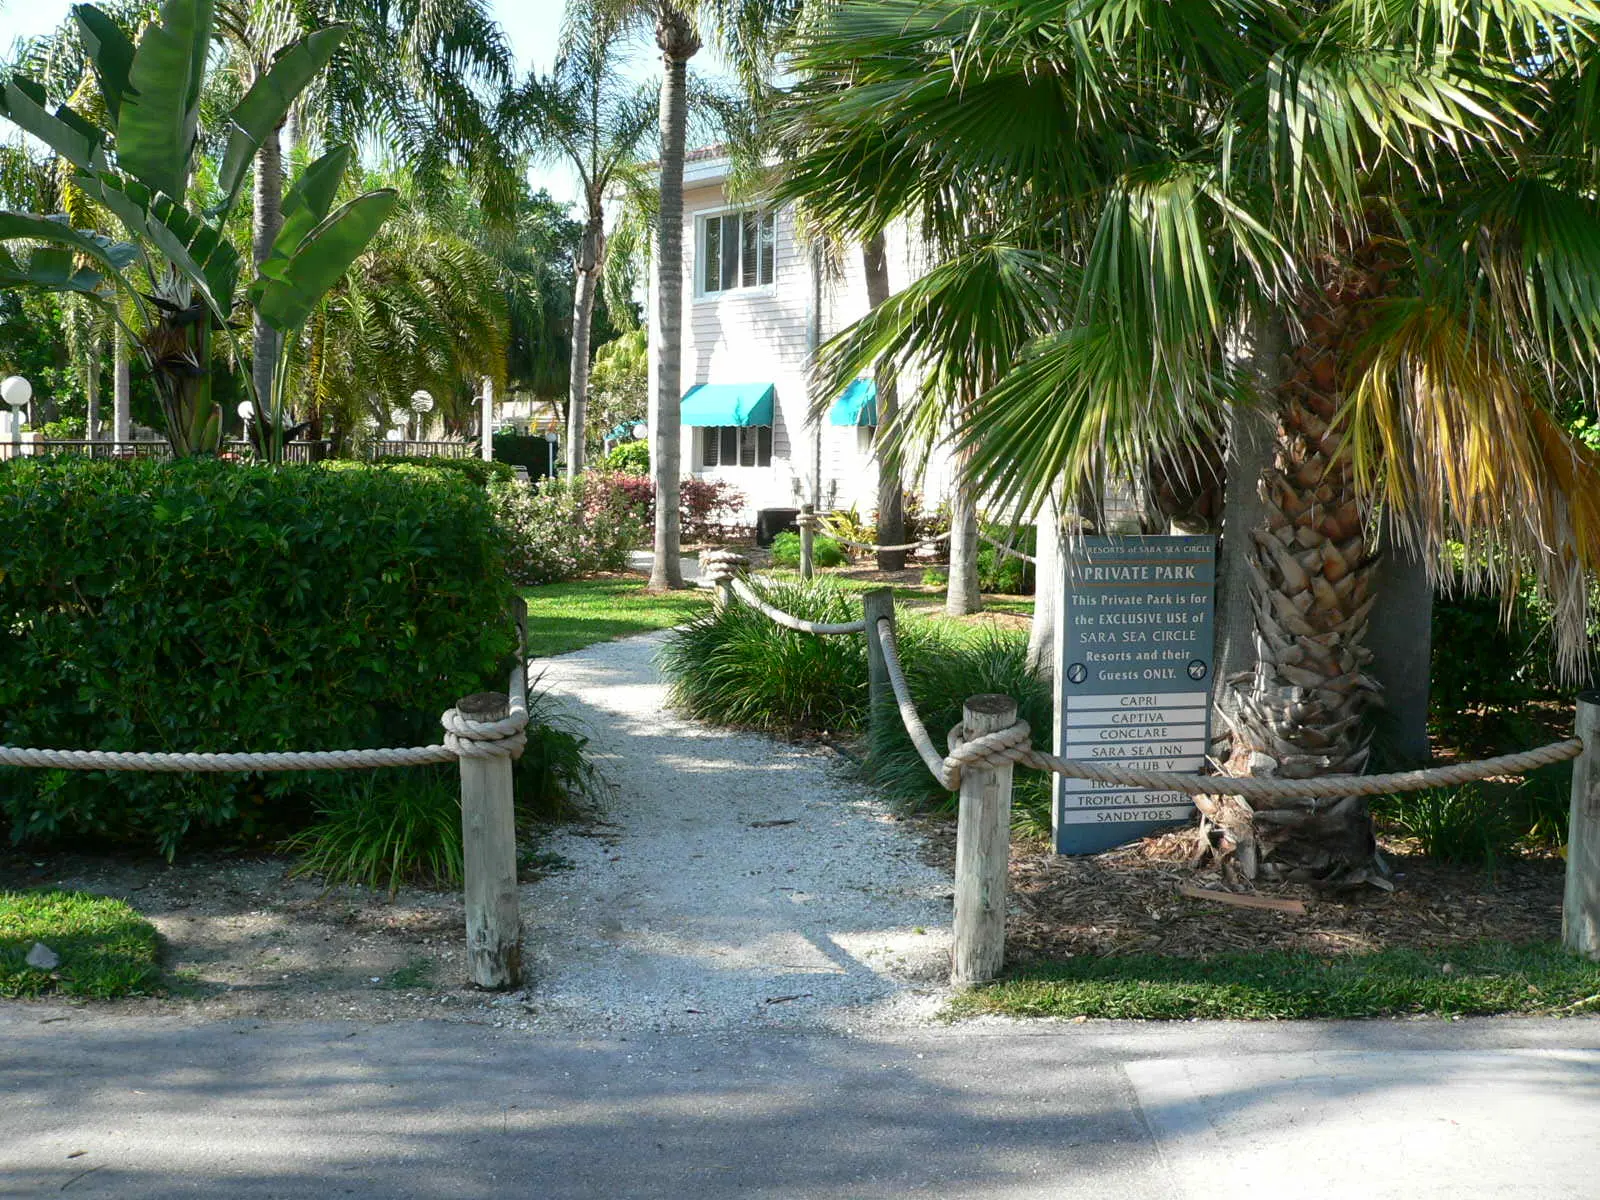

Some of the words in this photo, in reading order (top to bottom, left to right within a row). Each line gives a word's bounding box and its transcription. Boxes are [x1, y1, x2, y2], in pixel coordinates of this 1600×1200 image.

[1183, 545, 1211, 553] CIRCLE
[1084, 566, 1149, 580] PRIVATE
[1155, 565, 1195, 580] PARK
[1072, 595, 1097, 606] This
[1101, 594, 1142, 605] Private
[1147, 594, 1172, 605] Park
[1176, 594, 1185, 604] is
[1190, 593, 1207, 604] for
[1075, 614, 1094, 625] the
[1099, 613, 1161, 624] EXCLUSIVE
[1166, 613, 1187, 623] USE
[1192, 612, 1204, 623] of
[1080, 632, 1116, 643] SARA
[1122, 631, 1146, 642] SEA
[1152, 631, 1196, 642] CIRCLE
[1086, 651, 1131, 662] Resorts
[1136, 650, 1157, 660] and
[1162, 650, 1190, 660] their
[1098, 670, 1138, 681] Guests
[1143, 669, 1176, 680] ONLY.
[1120, 696, 1157, 706] CAPRI
[1111, 713, 1164, 723] CAPTIVA
[1099, 728, 1168, 740] CONCLARE
[1092, 747, 1126, 757] SARA
[1131, 746, 1154, 756] SEA
[1159, 745, 1183, 755] INN
[1166, 760, 1175, 769] V
[1078, 794, 1137, 806] TROPICAL
[1143, 793, 1192, 804] SHORES
